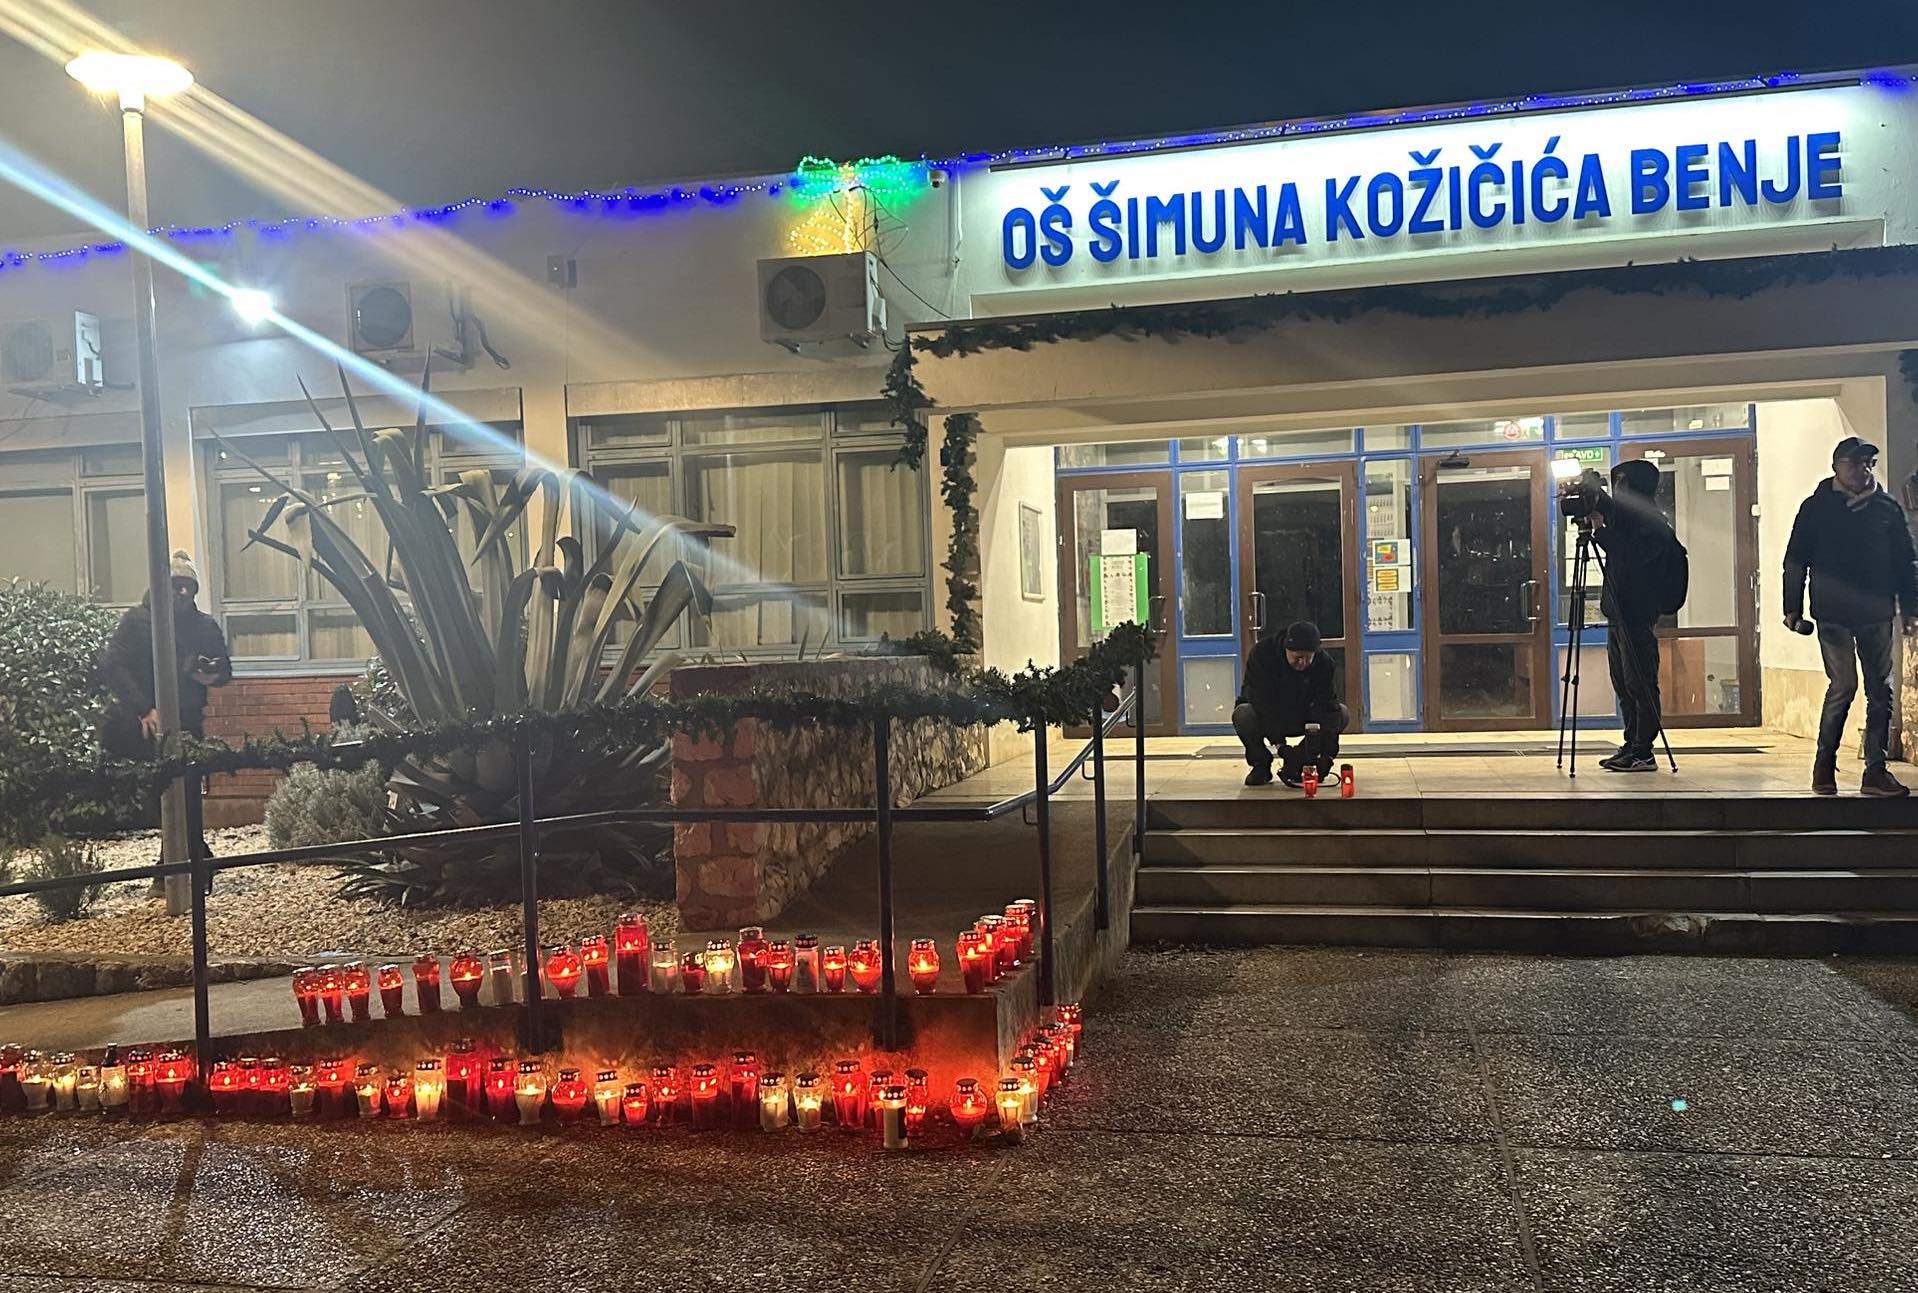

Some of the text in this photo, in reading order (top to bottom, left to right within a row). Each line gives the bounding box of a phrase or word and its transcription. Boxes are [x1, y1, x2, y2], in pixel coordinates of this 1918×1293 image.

[1002, 131, 1843, 269] OŠ ŠIMUNA KOŽIČIĆA BENJE
